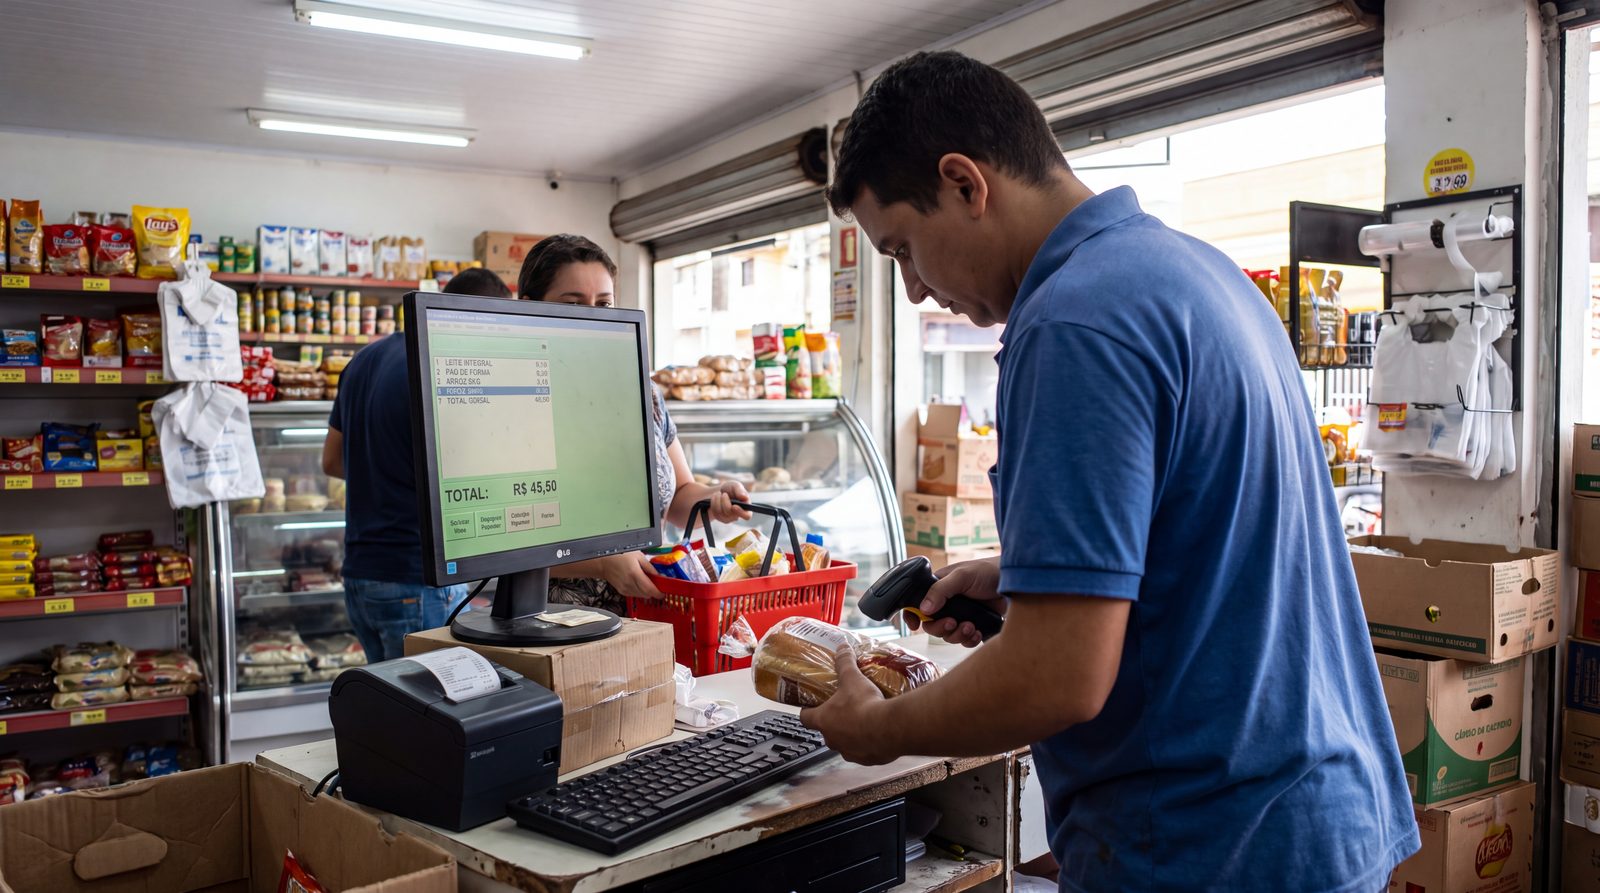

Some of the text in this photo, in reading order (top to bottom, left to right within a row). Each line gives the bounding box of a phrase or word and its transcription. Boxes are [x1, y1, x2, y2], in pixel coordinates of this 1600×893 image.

[464, 359, 493, 367] INTEGRAL
[445, 480, 557, 503] TOTAL: R$ 45,50
